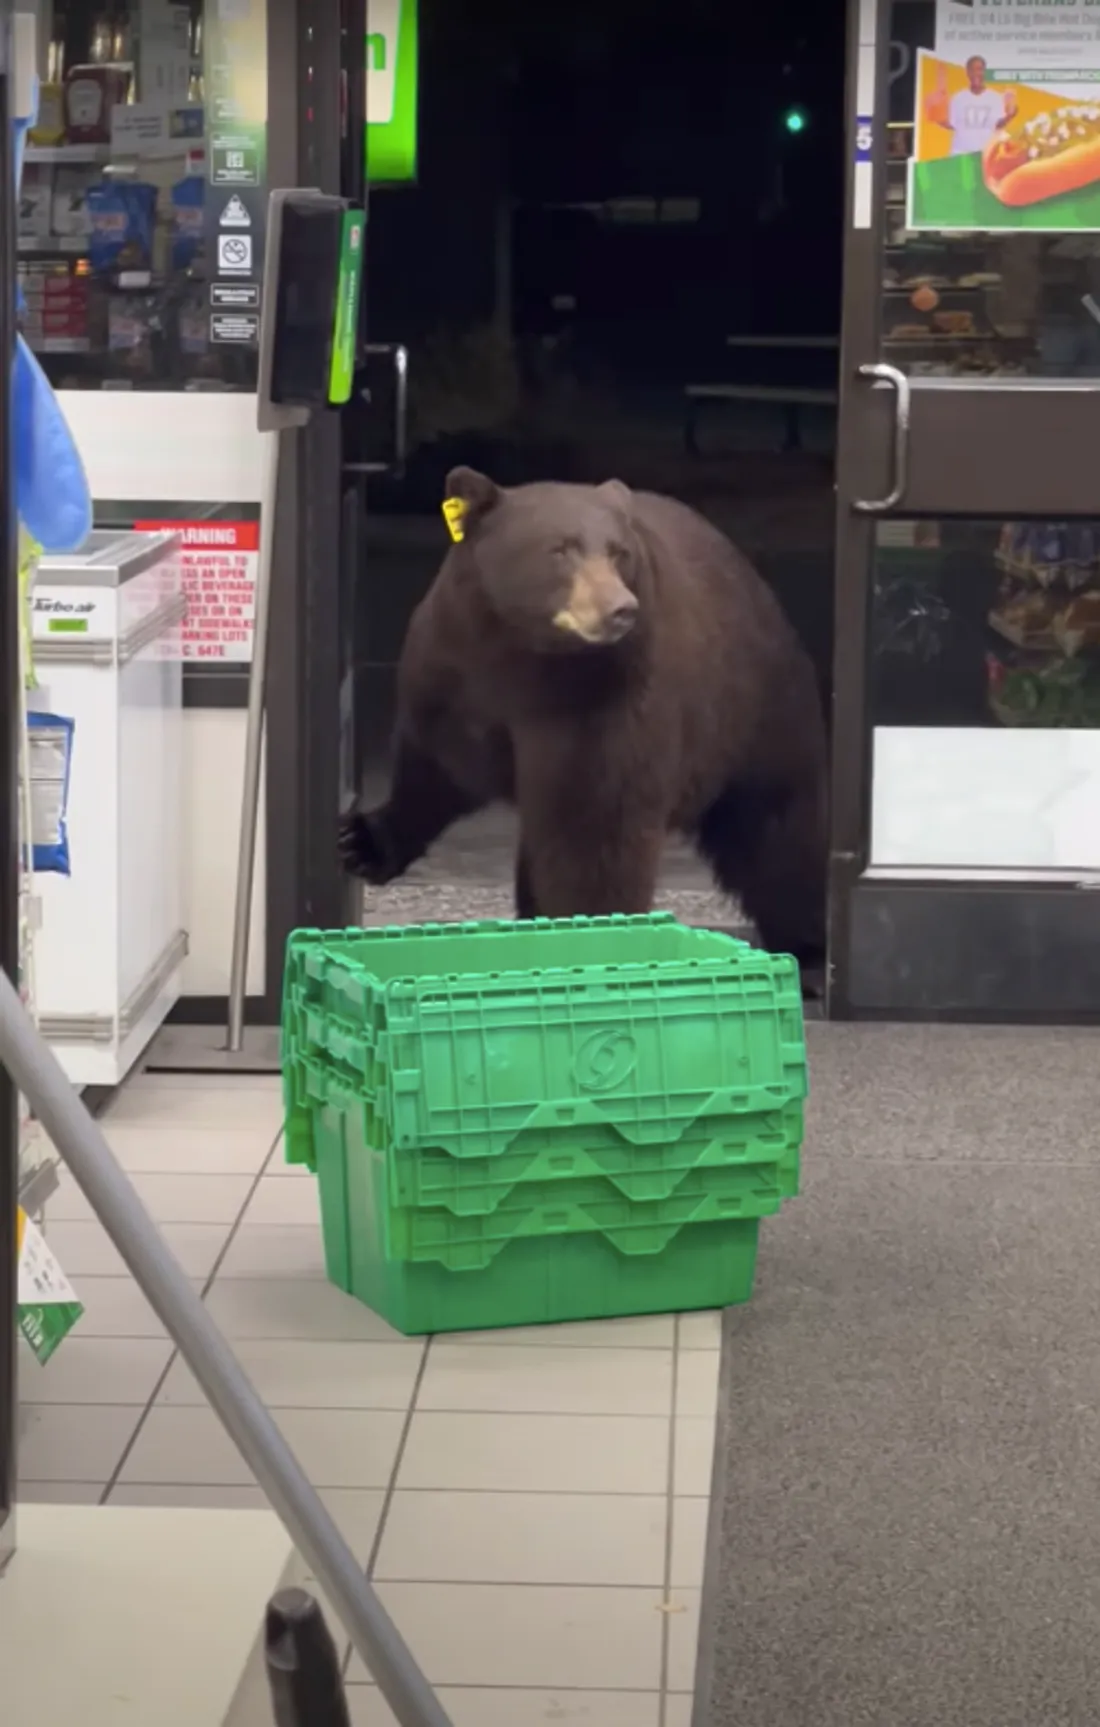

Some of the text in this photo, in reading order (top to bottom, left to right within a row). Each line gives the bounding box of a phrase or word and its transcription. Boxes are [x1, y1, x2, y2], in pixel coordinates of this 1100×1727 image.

[958, 30, 993, 40] active
[995, 31, 1037, 40] service
[235, 556, 248, 566] TO
[202, 568, 215, 578] AN
[218, 568, 246, 578] OPEN
[205, 594, 218, 604] ON
[223, 594, 252, 604] THESE
[211, 606, 225, 616] OR
[229, 606, 242, 616] ON
[182, 631, 247, 641] ARKING LOTS
